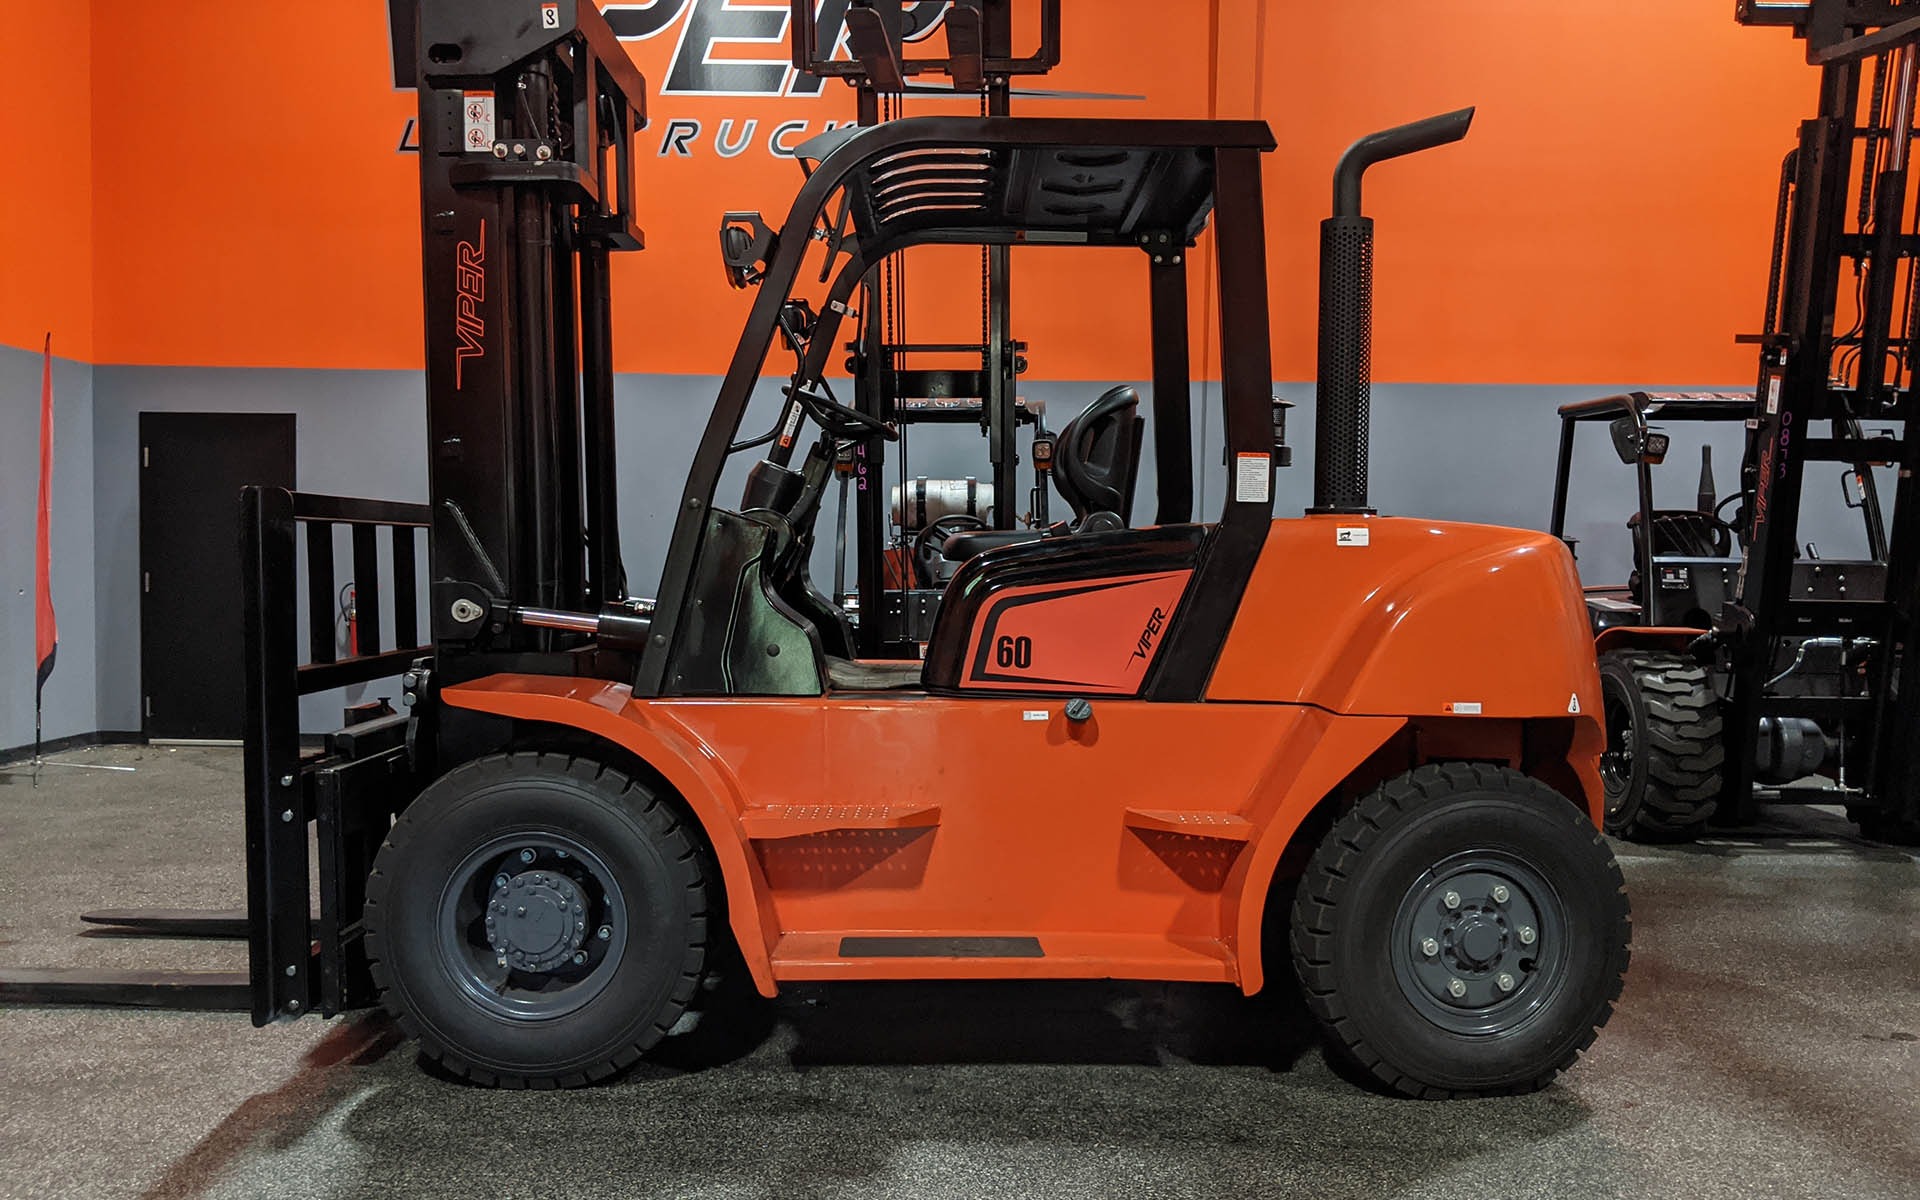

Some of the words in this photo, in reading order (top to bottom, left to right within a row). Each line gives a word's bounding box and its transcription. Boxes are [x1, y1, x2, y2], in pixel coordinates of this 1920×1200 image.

[456, 219, 485, 391] VIPER
[997, 635, 1032, 669] 60
[1129, 603, 1170, 665] VIPER
